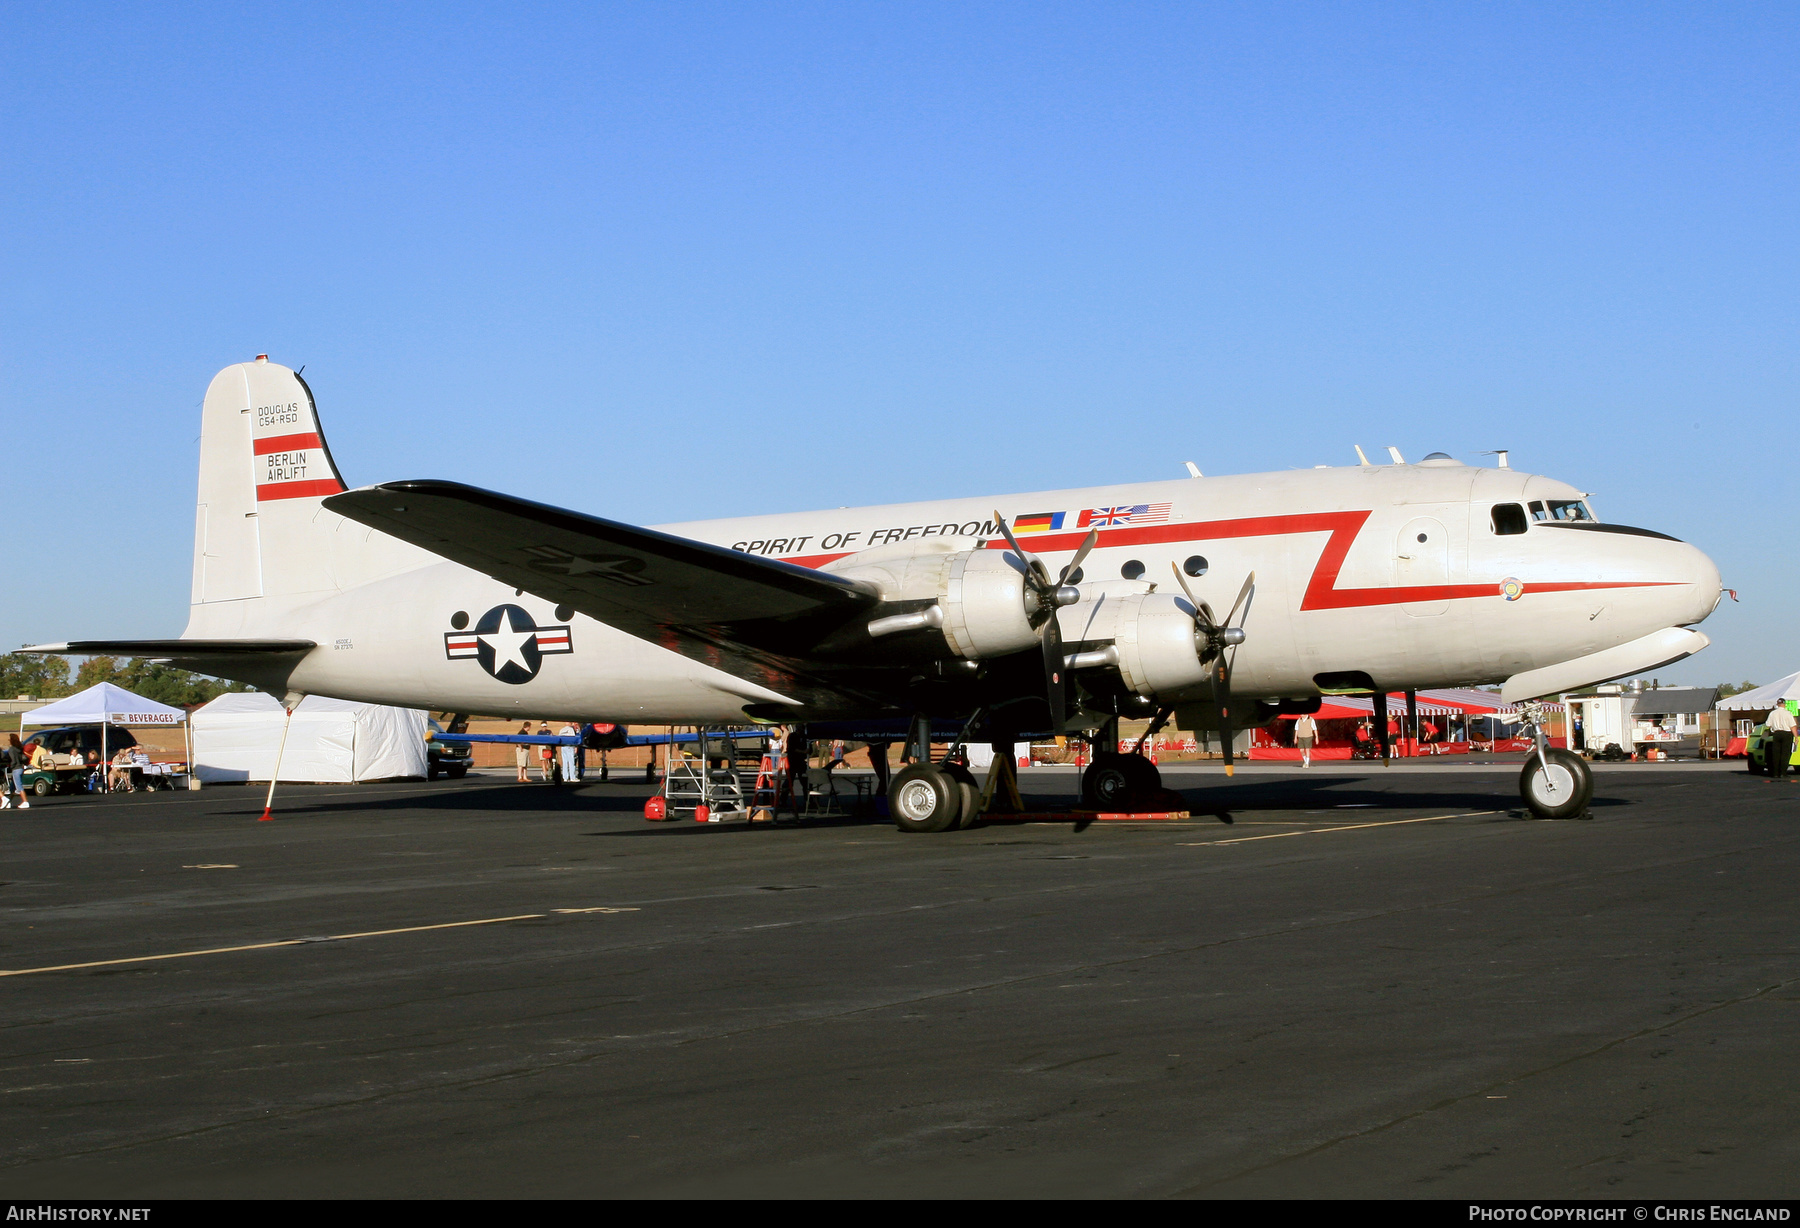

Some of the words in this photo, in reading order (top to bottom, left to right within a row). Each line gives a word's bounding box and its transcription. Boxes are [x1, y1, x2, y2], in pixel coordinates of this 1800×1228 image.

[258, 402, 298, 417] DOUGLAS
[259, 413, 298, 427] C54-R5D
[268, 452, 306, 467] BERLIN
[267, 466, 307, 481] AIRLIFT
[731, 536, 813, 555] SPIRIT
[821, 531, 861, 550] OF
[867, 518, 1007, 546] FREEDOM
[128, 713, 174, 722] BEVERAGES
